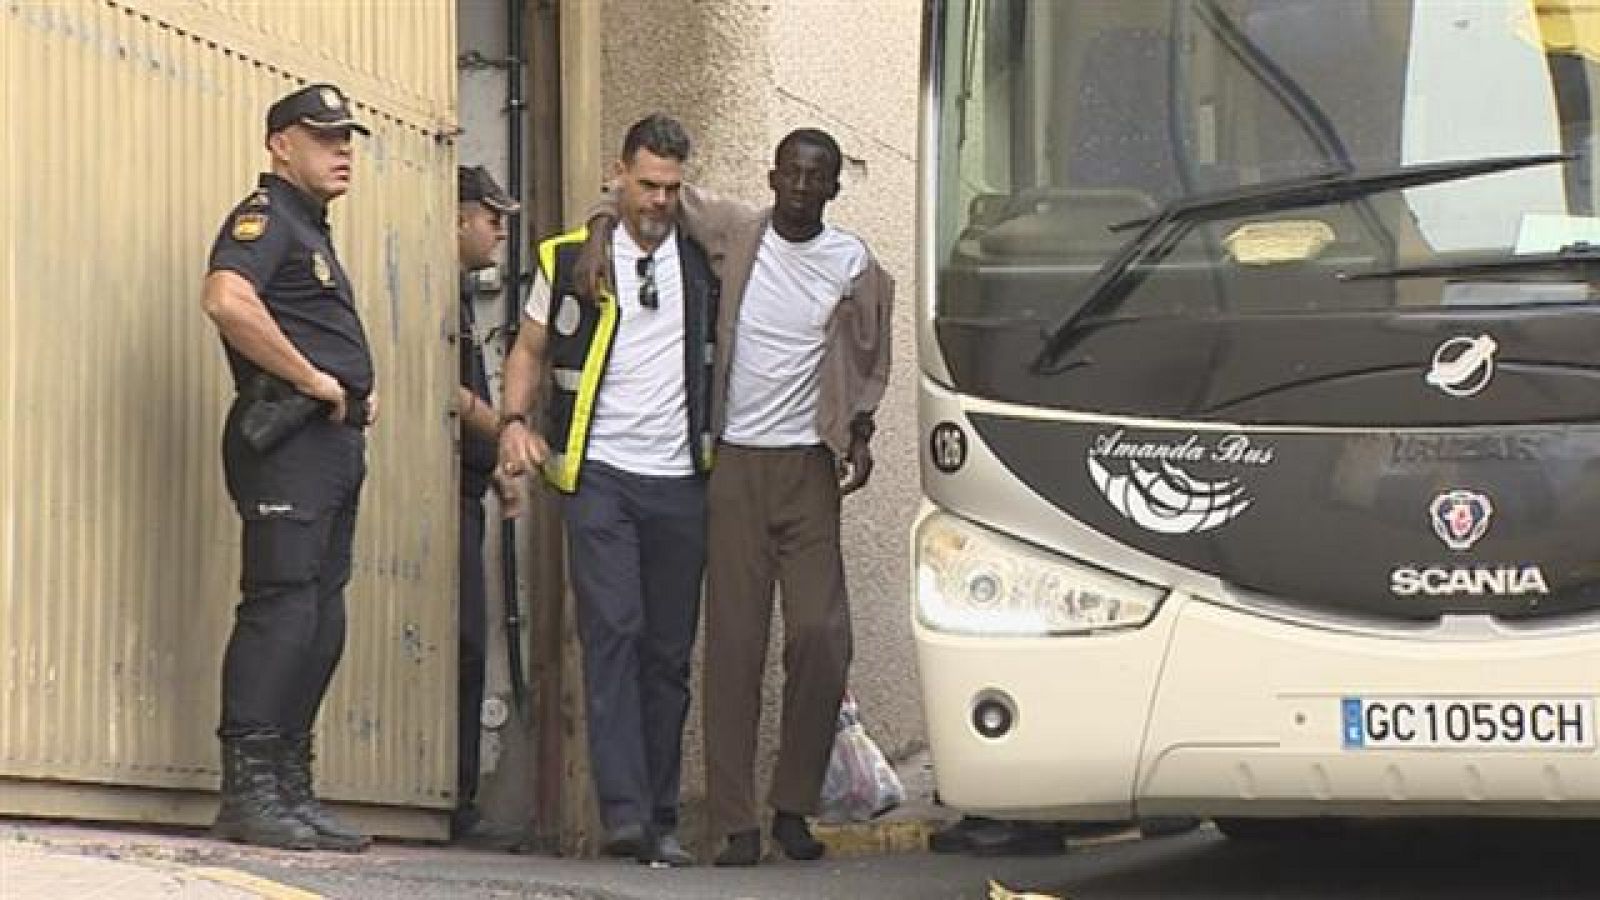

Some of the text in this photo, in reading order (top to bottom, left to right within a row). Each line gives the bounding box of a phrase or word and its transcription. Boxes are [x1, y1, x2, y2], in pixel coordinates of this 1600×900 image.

[1089, 429, 1274, 464] Amanda Bus
[1390, 567, 1550, 595] SCANIA
